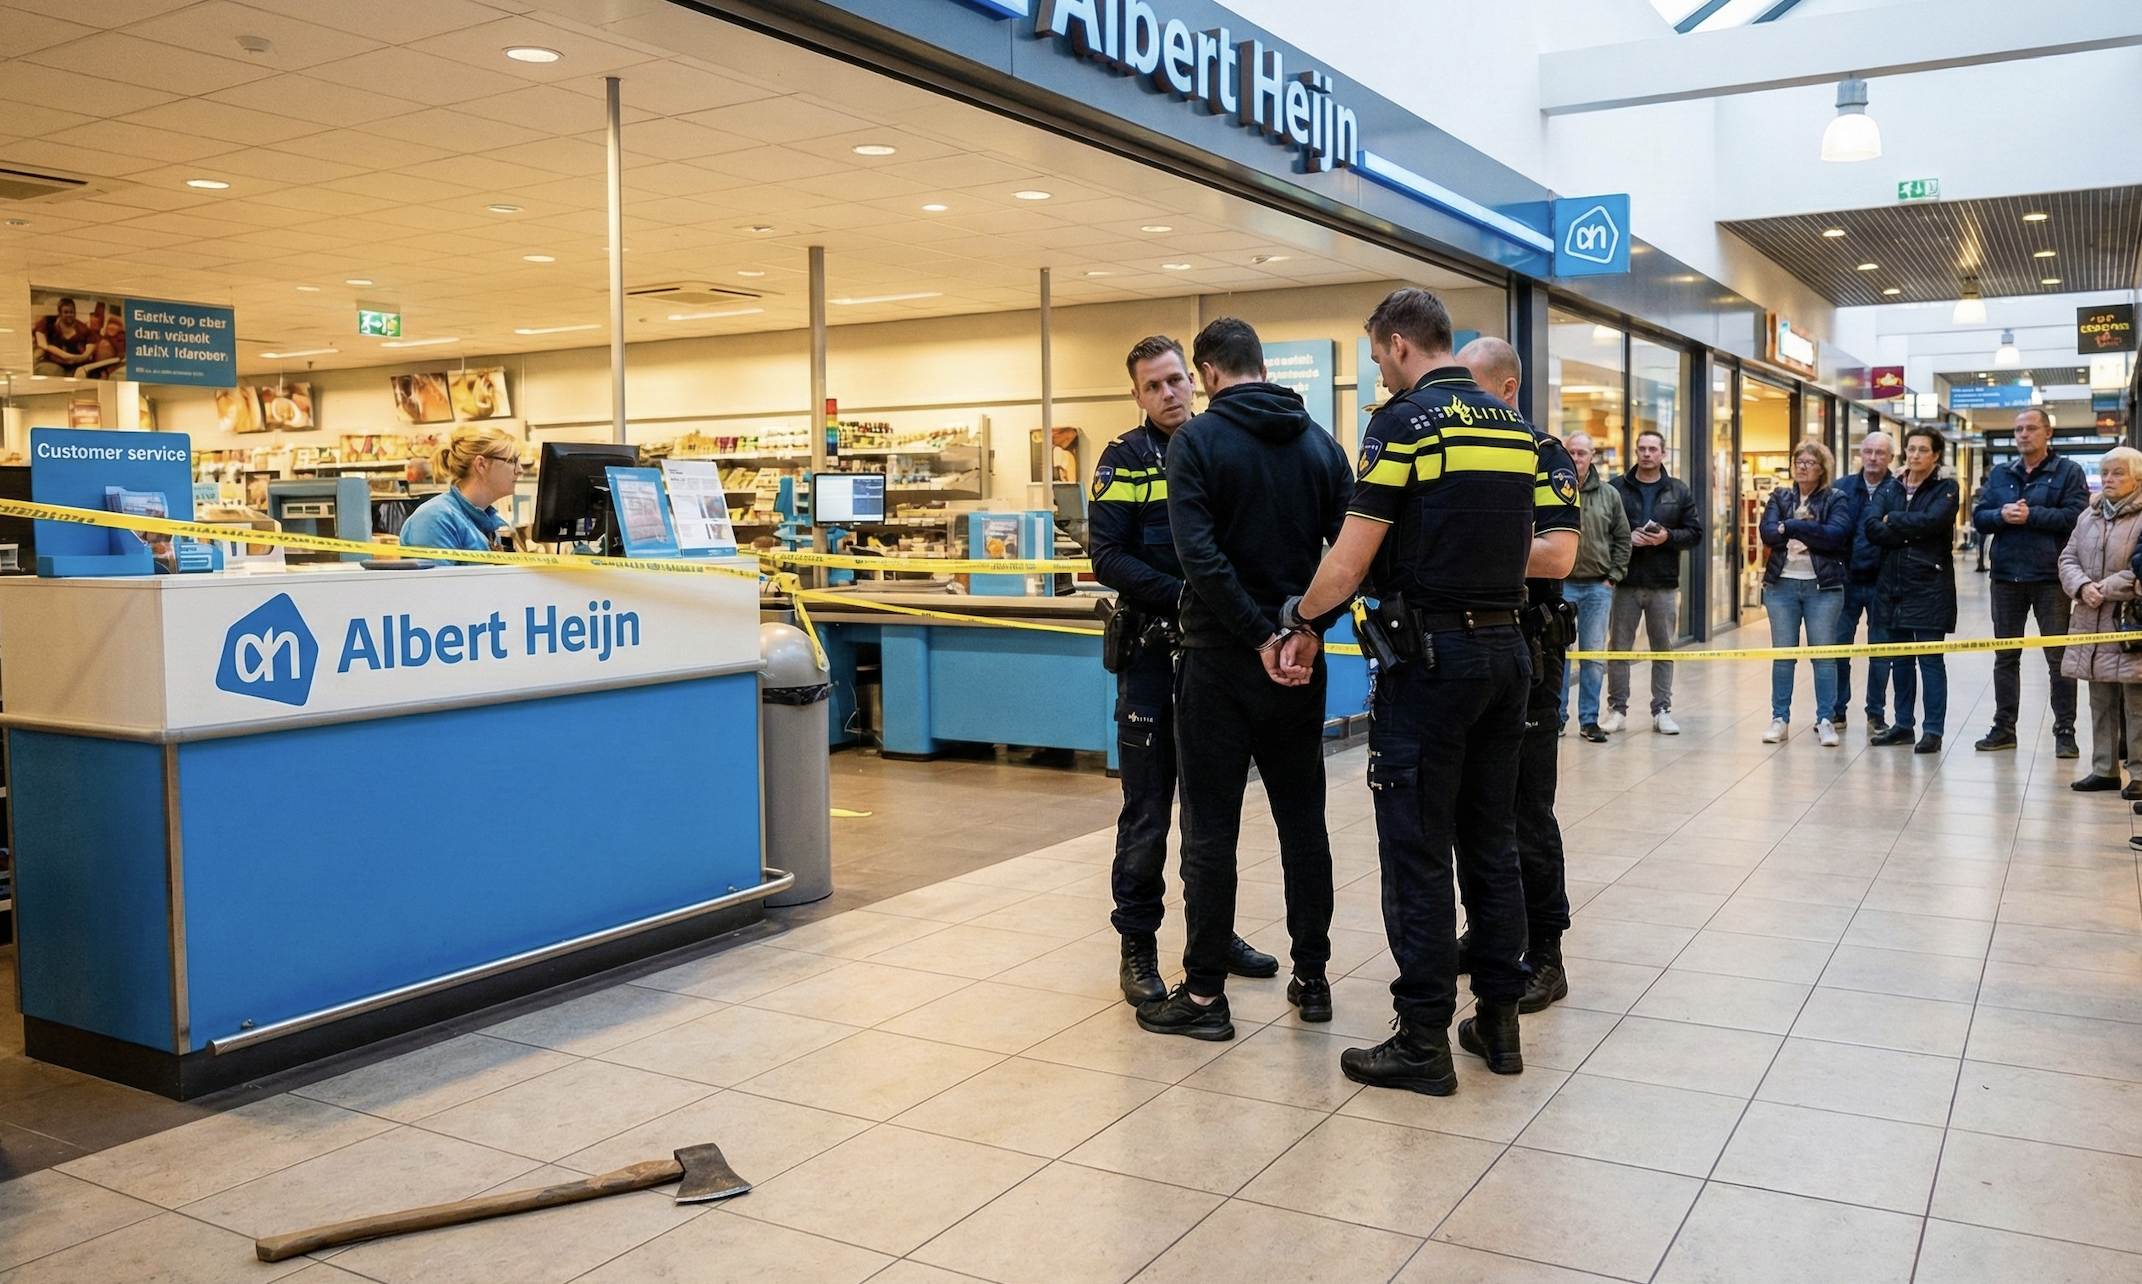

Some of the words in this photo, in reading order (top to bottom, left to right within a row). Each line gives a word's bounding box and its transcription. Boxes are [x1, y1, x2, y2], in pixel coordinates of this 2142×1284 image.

[1253, 39, 1358, 173] Heijn
[179, 316, 195, 328] op
[37, 442, 123, 460] Customer
[127, 446, 187, 462] service
[336, 610, 508, 674] Albert
[524, 599, 640, 662] Heijn
